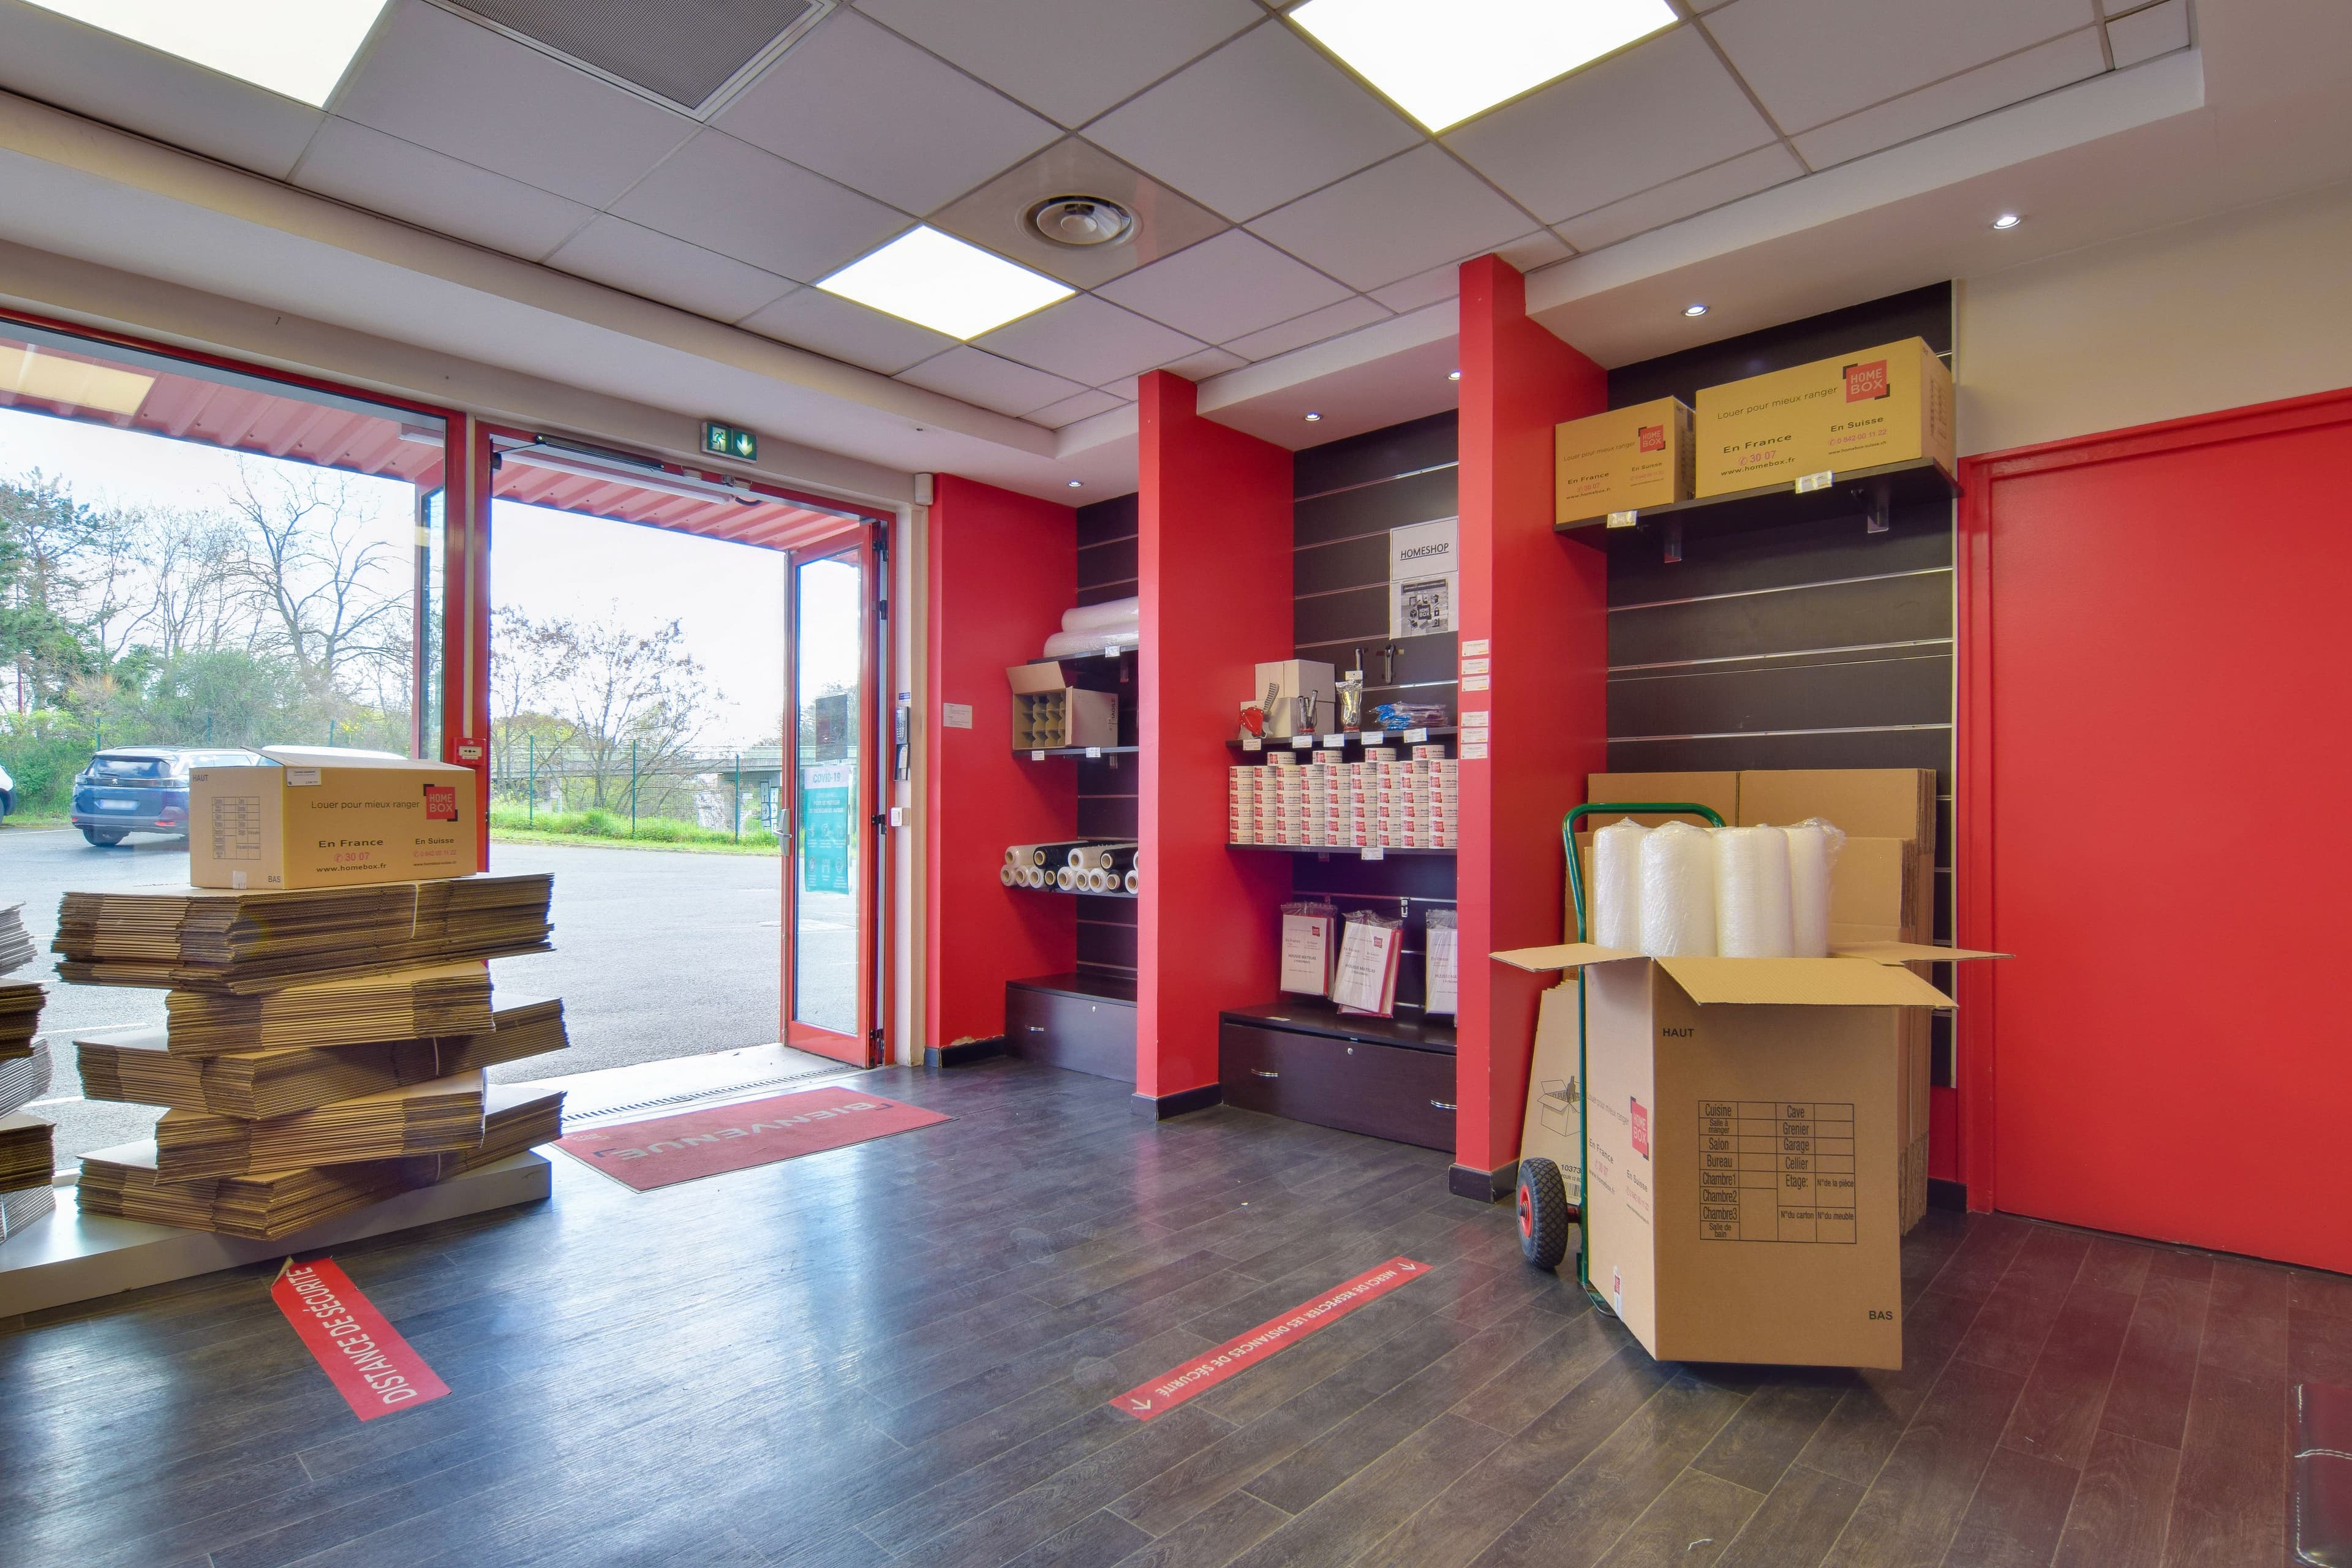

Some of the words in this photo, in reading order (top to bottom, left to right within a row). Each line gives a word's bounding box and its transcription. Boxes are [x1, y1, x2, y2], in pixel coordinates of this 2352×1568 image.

[1850, 368, 1882, 383] HOME
[1850, 380, 1883, 395] BOX
[1717, 408, 1744, 420] Louer
[1747, 402, 1769, 415] pour
[1772, 395, 1801, 407] mieux
[1804, 387, 1838, 401] ranger
[1847, 417, 1883, 429] Suisse
[1643, 430, 1662, 440] HOME
[1616, 441, 1635, 450] ranger
[1643, 438, 1662, 447] BOX
[1723, 445, 1740, 454] En
[1745, 433, 1792, 450] France
[1750, 453, 1762, 464] 30
[1764, 450, 1777, 461] 07
[1721, 456, 1796, 477] www.homebox.fr
[1581, 472, 1610, 482] France
[1401, 543, 1449, 559] HOMESHOP
[813, 772, 841, 783] COVID-19
[429, 794, 452, 802] HOME
[393, 801, 420, 809] ranger
[429, 803, 453, 812] BOX
[345, 853, 356, 861] 30
[359, 852, 370, 861] 07
[316, 863, 387, 872] www.homebox.fr
[1662, 1028, 1694, 1037] HAUT
[1705, 1103, 1732, 1116] Cuisine
[1787, 1105, 1804, 1118] Cave
[1634, 1113, 1646, 1131] HOME
[1724, 1118, 1728, 1126] à
[1783, 1121, 1809, 1135] Grenier
[612, 1101, 876, 1161] BIENVENUE
[1634, 1126, 1647, 1145] BOX
[1709, 1126, 1730, 1135] manger
[1709, 1137, 1728, 1150] Salon
[1784, 1137, 1809, 1153] Garage
[1589, 1138, 1596, 1148] En
[1597, 1144, 1614, 1164] France
[1706, 1155, 1732, 1167] Bureau
[1785, 1156, 1808, 1170] Cellier
[1627, 1170, 1633, 1181] En
[1634, 1174, 1648, 1192] Suisse
[1703, 1172, 1736, 1186] Chambre1
[1785, 1174, 1808, 1189] Etage:
[1839, 1179, 1854, 1188] pièce
[1703, 1189, 1737, 1202] Chambre2
[1703, 1206, 1737, 1220] Chambre3
[1365, 1270, 1397, 1286] MERCI
[1352, 1284, 1370, 1293] DE
[1303, 1291, 1357, 1318] RESPECTER
[1287, 1315, 1308, 1327] LES
[1869, 1310, 1893, 1320] BAS
[322, 1315, 361, 1336] DE
[1228, 1325, 1291, 1357] DISTANCES
[1210, 1355, 1232, 1367] DE
[337, 1333, 418, 1404] DISTANCE
[1155, 1364, 1214, 1396] SÉCURITÉ
